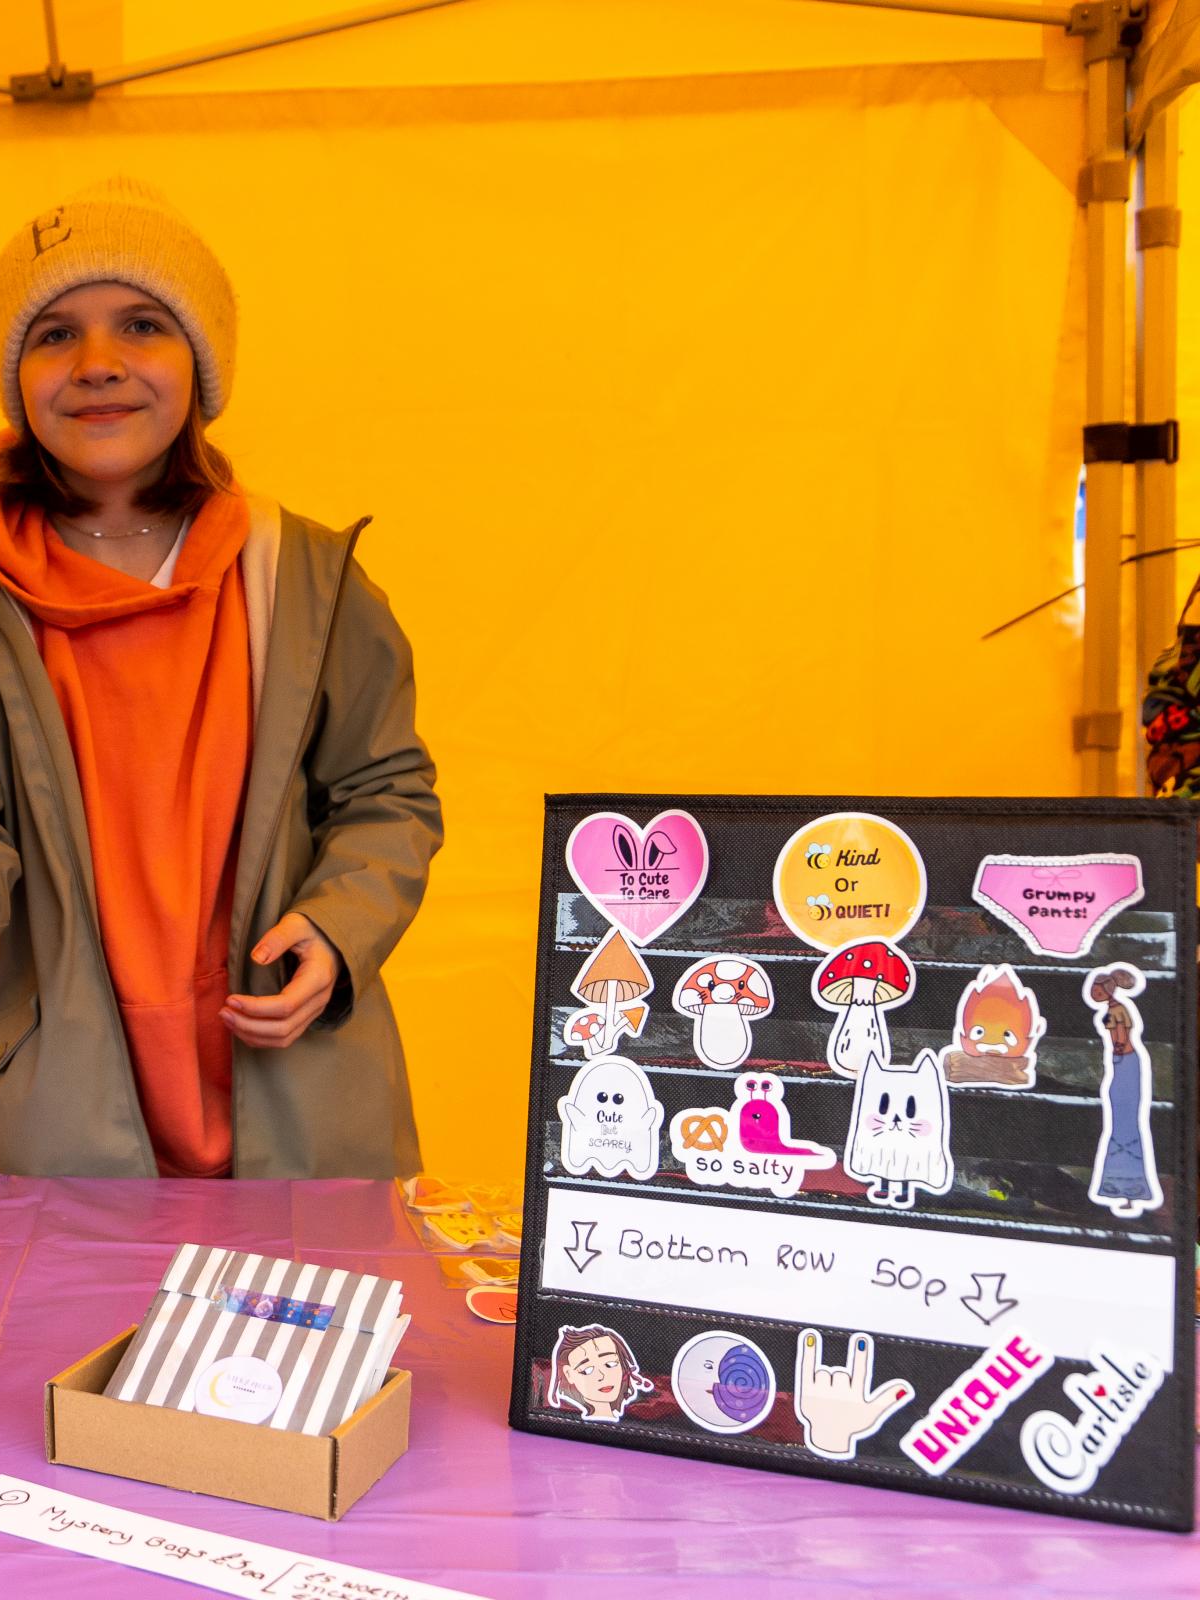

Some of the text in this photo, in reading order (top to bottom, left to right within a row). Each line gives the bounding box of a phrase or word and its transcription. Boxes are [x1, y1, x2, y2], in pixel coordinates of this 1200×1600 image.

[29, 206, 72, 261] E
[835, 848, 881, 867] Kind
[619, 872, 669, 886] To Cute
[834, 877, 859, 893] Or
[619, 887, 670, 900] To Care
[1022, 888, 1096, 904] Grumpy
[835, 903, 891, 919] QUIET!
[596, 1109, 623, 1124] Cute
[618, 1229, 749, 1267] Bottom
[871, 1258, 947, 1307] 50p
[912, 1335, 1043, 1465] UNIQUE
[1034, 1353, 1149, 1480] Carlisle
[38, 1505, 133, 1546] Mystery
